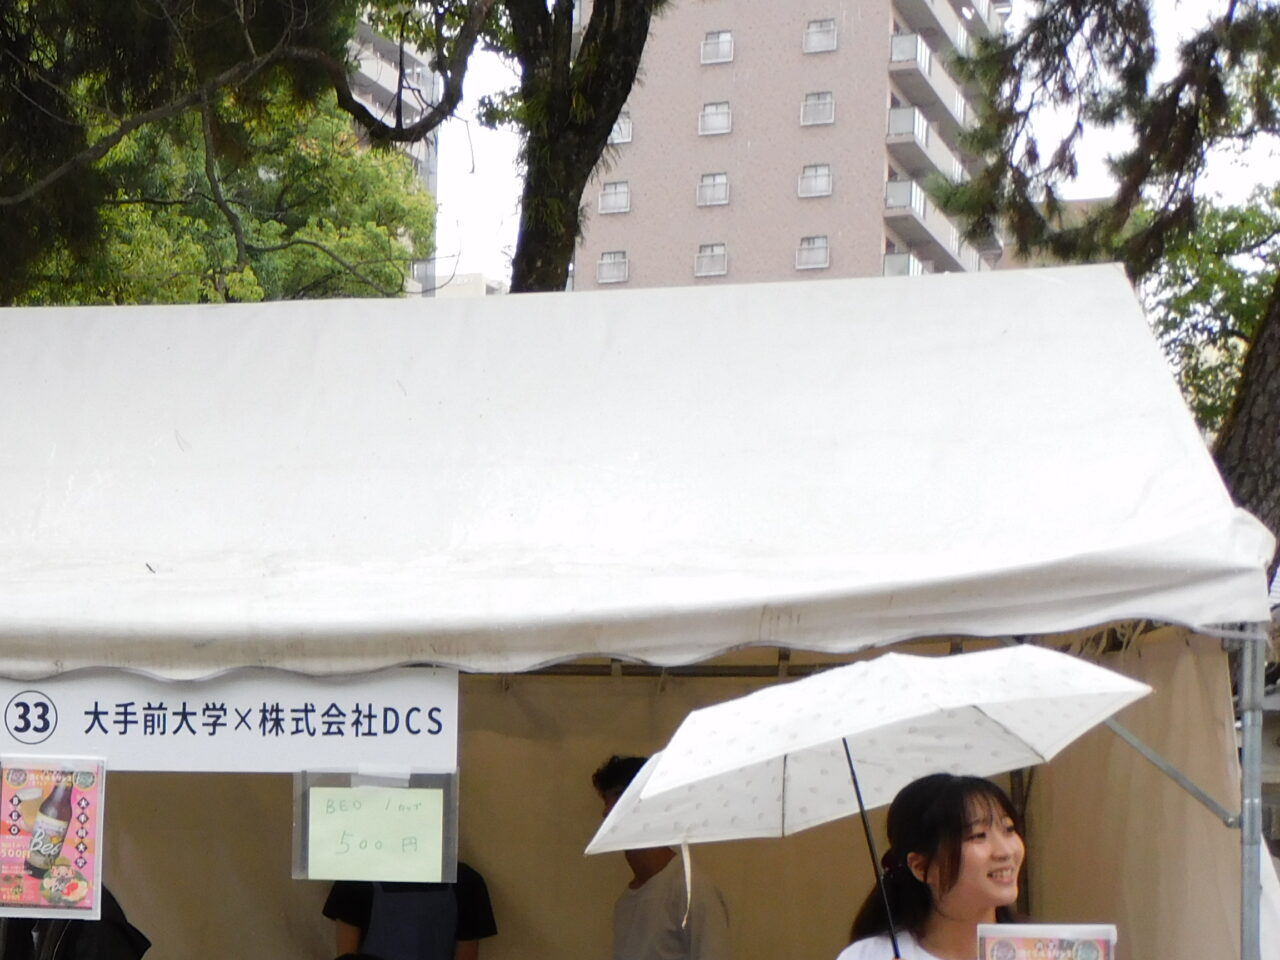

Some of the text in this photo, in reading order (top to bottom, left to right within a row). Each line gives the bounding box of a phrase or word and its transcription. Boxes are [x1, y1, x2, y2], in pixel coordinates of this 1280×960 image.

[83, 700, 444, 737] 大手前大学×株式会社DCS
[325, 799, 362, 814] BEO
